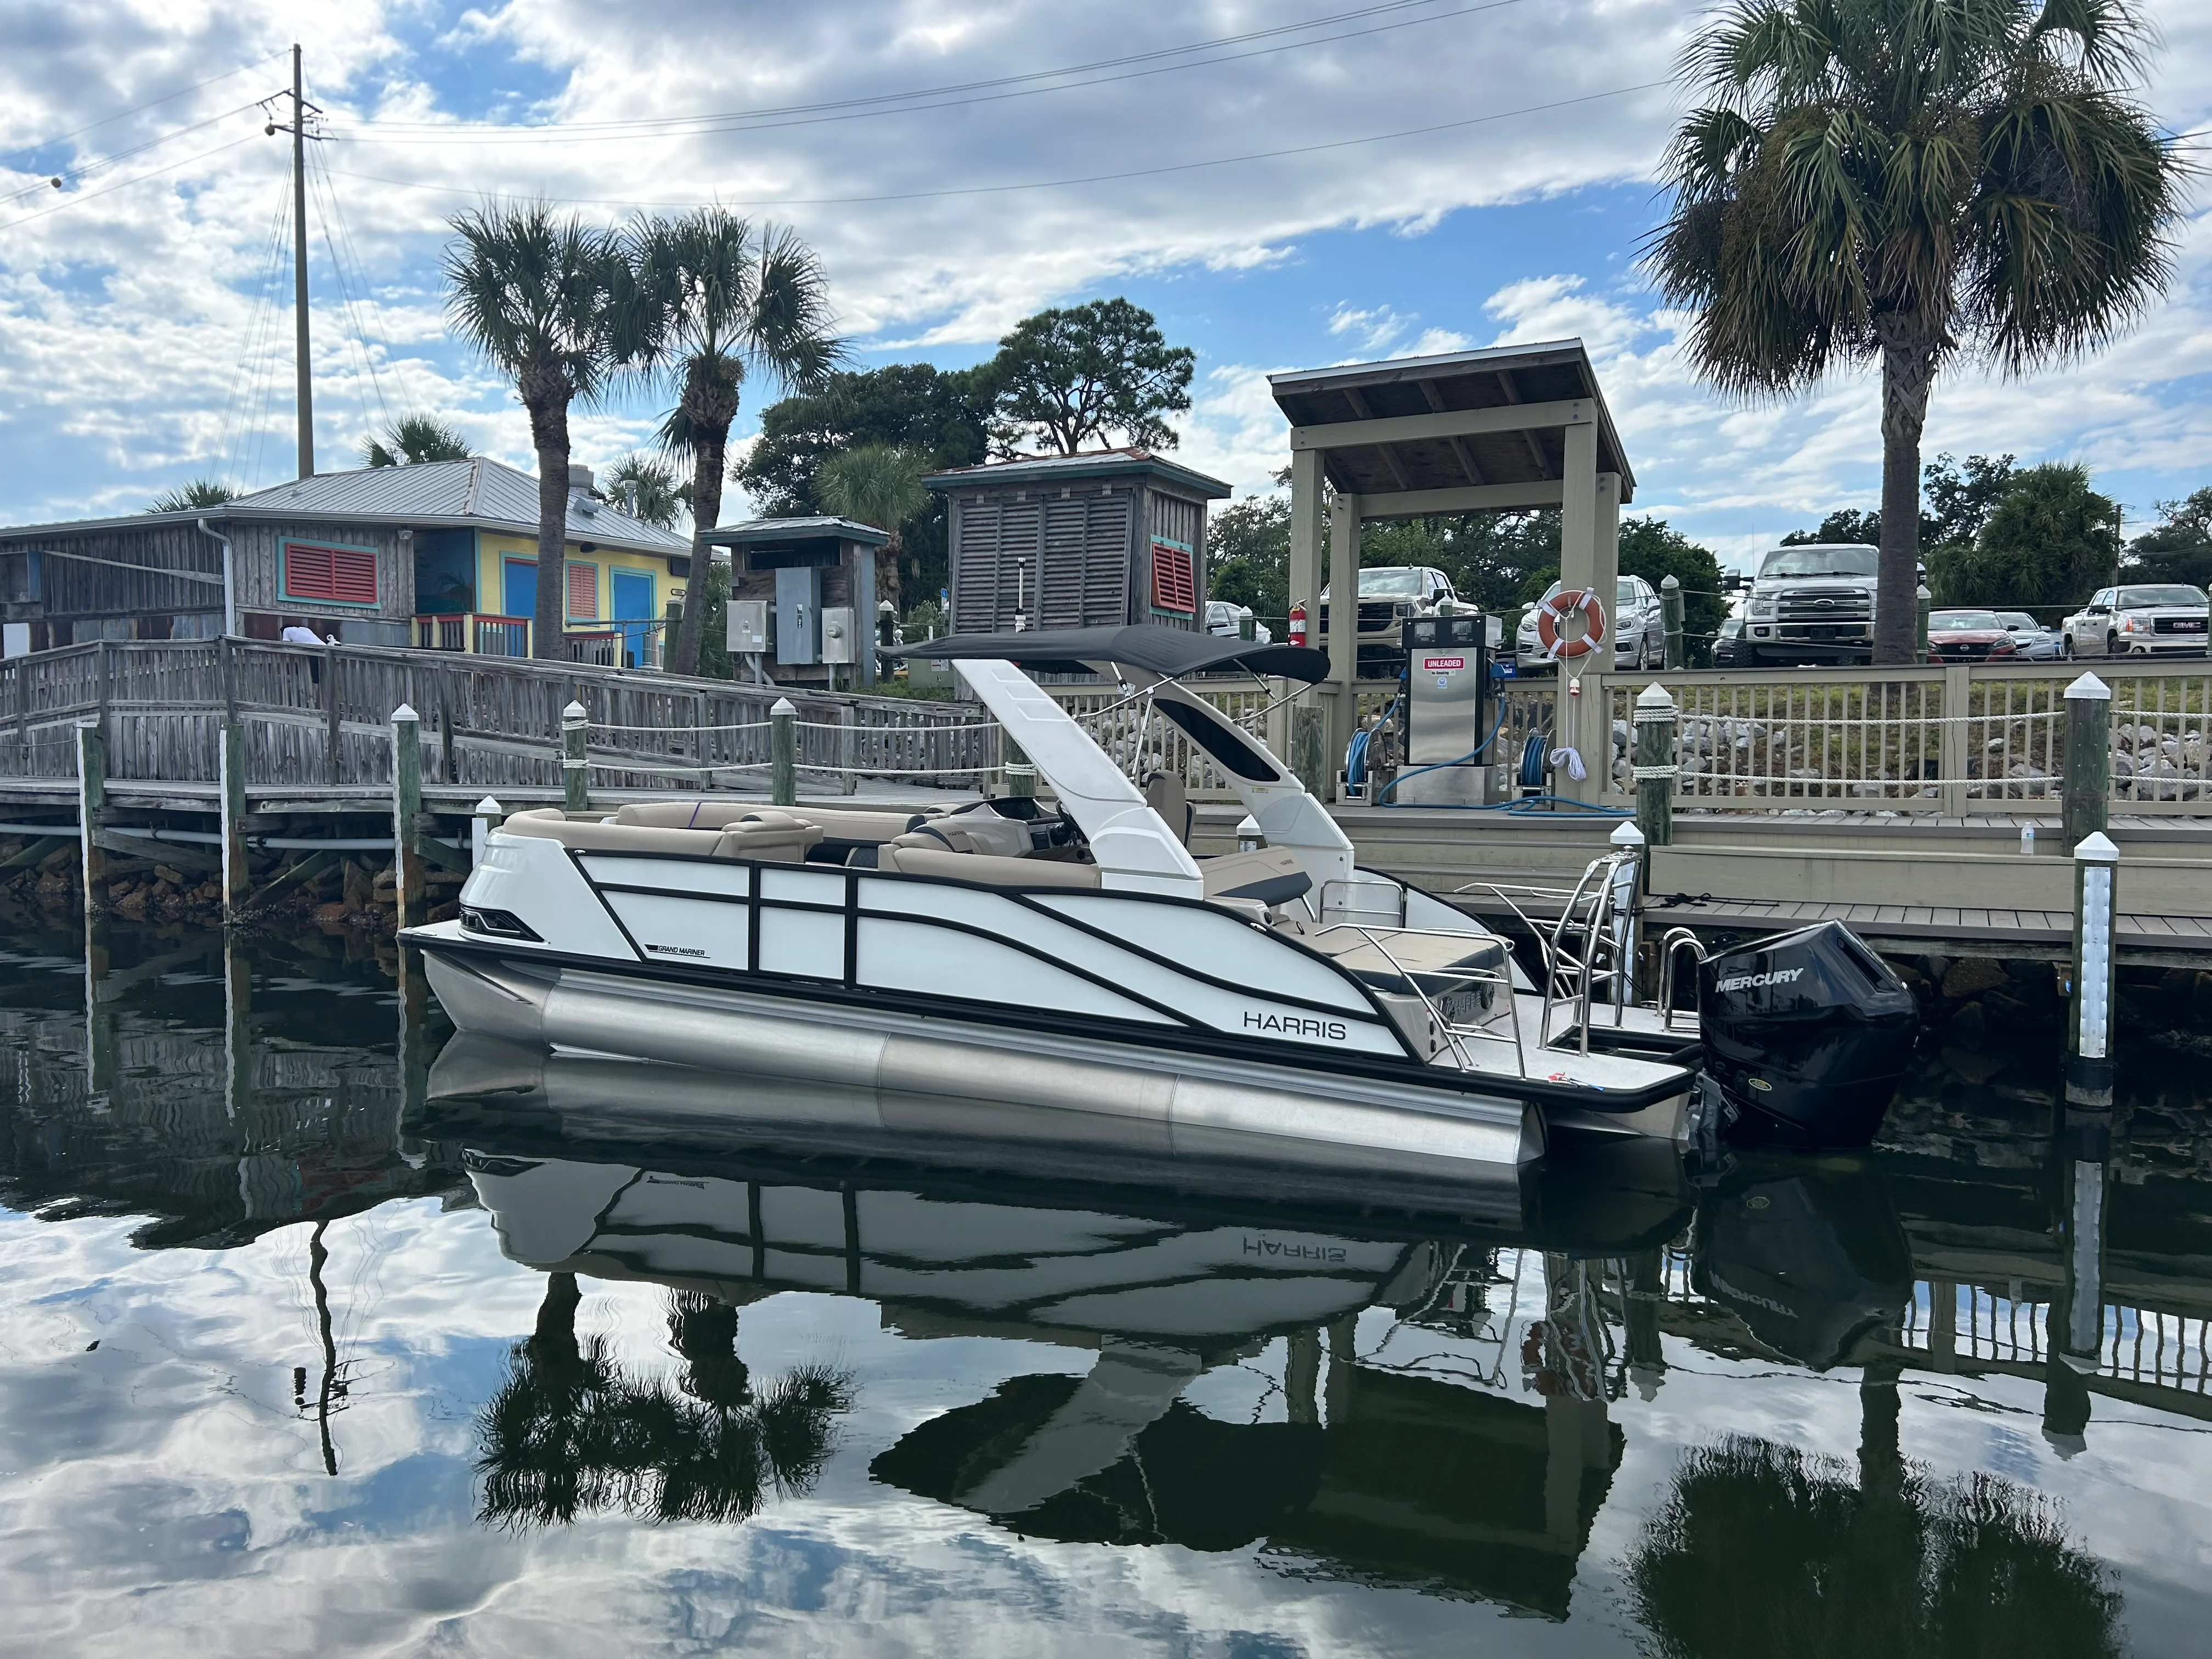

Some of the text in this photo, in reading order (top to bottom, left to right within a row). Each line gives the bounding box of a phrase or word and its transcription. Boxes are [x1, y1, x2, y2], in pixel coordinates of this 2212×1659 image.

[679, 947, 705, 956] MARINER
[1715, 968, 1804, 993] MERCURY
[1454, 990, 1482, 1016] HARRIS
[1244, 1011, 1346, 1040] HARRIS
